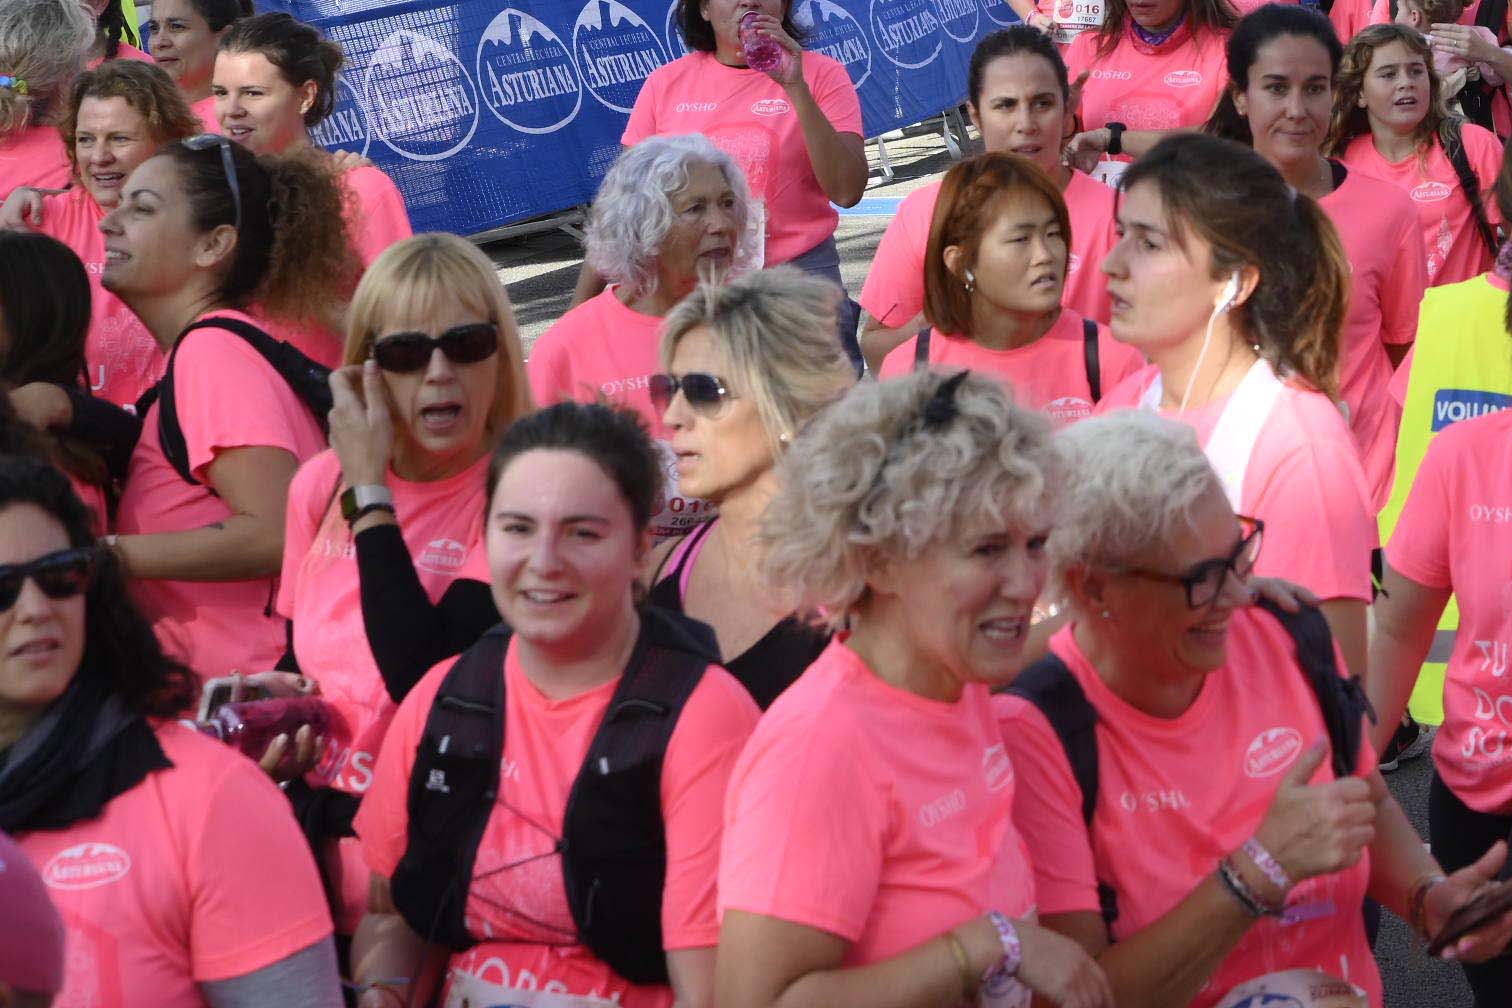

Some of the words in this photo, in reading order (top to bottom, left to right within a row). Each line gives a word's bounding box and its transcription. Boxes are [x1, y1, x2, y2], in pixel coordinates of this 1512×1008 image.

[1075, 3, 1100, 15] 016
[880, 10, 939, 53] ASTURIANA
[486, 59, 578, 109] ASTURIANA
[582, 44, 663, 89] ASTURIANA
[375, 82, 474, 136] ASTURIANA
[676, 101, 718, 113] OYSHO
[602, 375, 651, 396] OYSH
[1477, 640, 1507, 677] TU
